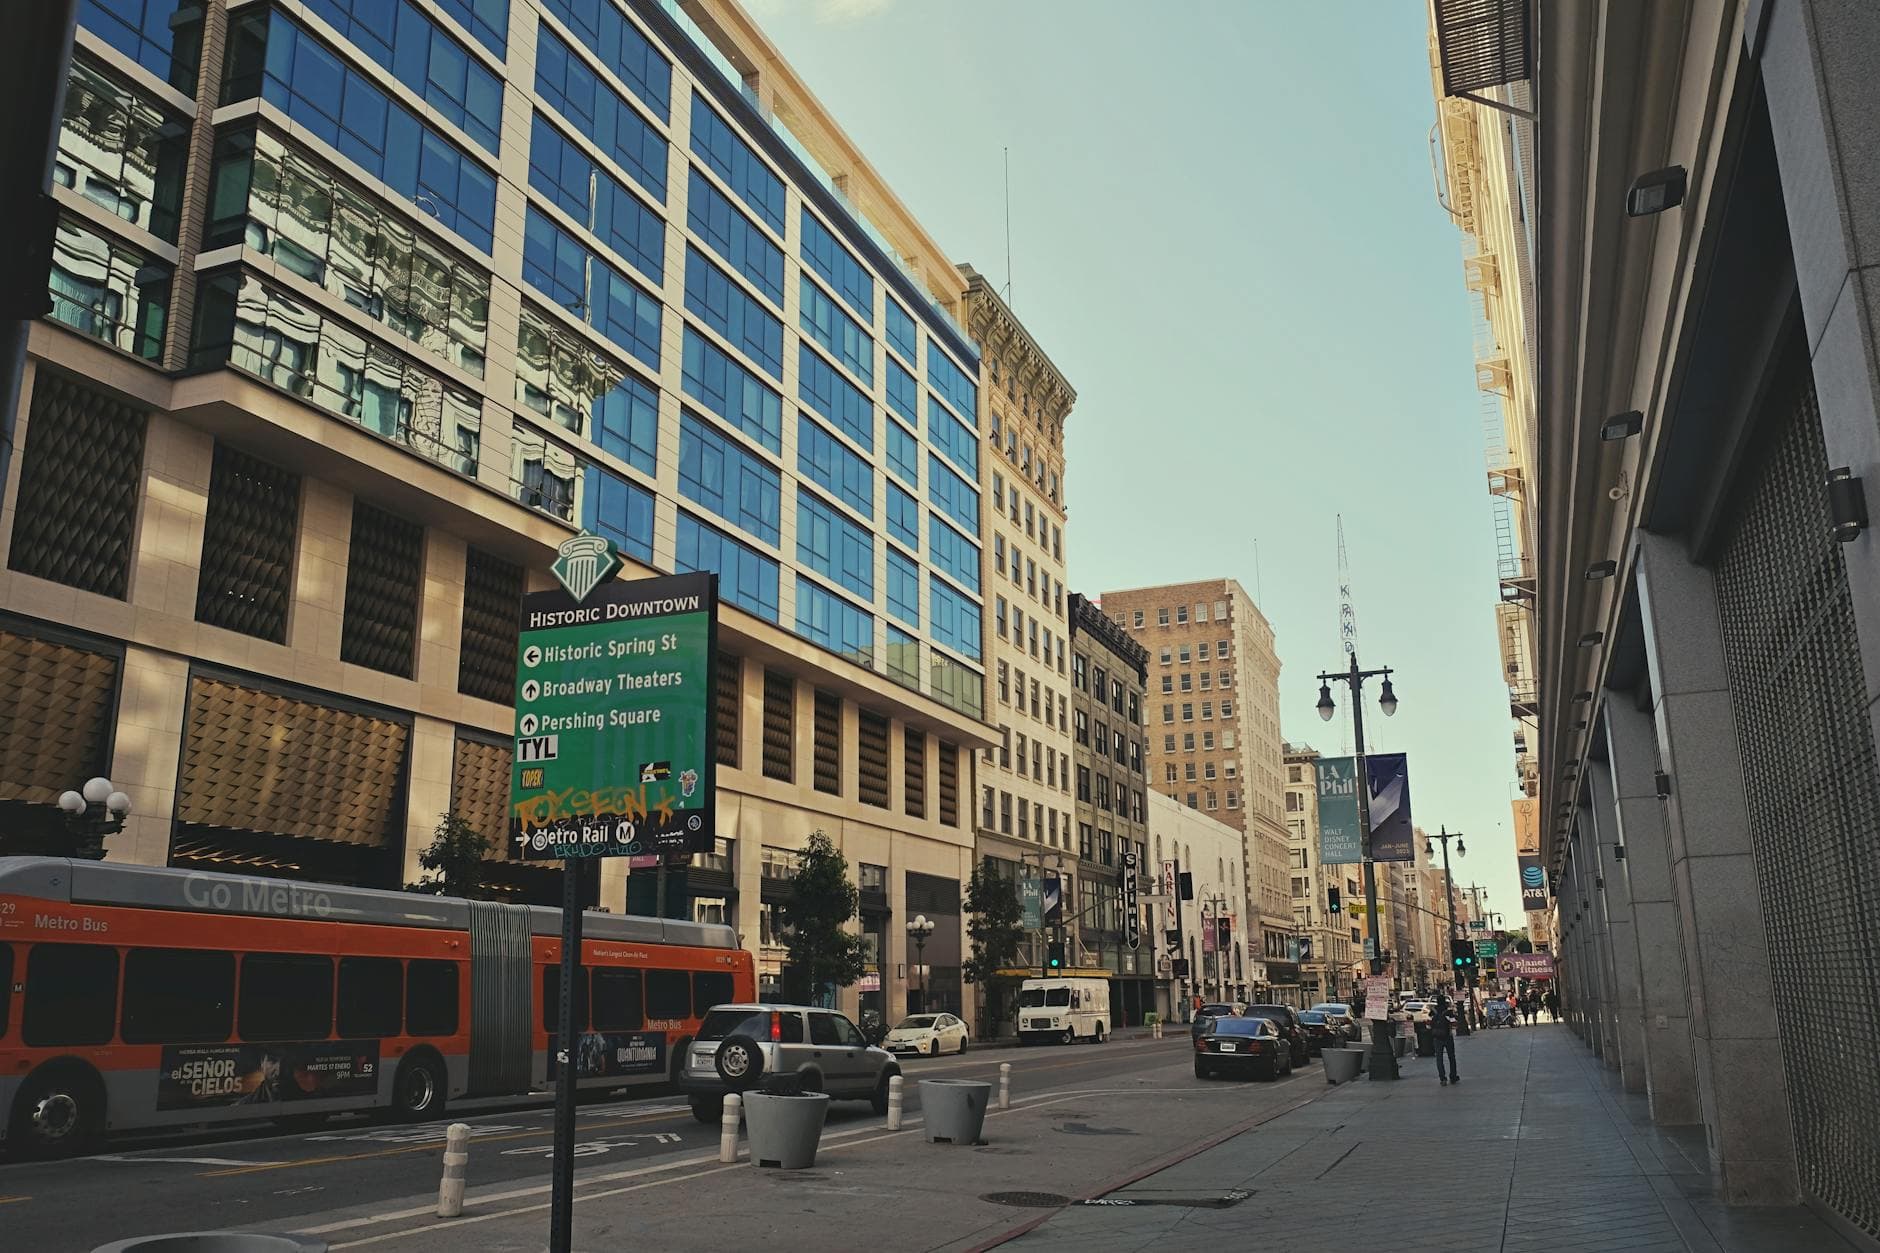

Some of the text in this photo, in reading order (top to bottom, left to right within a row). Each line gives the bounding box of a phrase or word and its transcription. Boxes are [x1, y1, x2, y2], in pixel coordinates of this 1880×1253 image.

[544, 633, 678, 663] Historic Spring St
[543, 671, 682, 698] Broadway Theaters
[541, 708, 661, 731] Pershing Square
[518, 737, 556, 761] TYL
[1319, 765, 1340, 780] LA
[1320, 778, 1353, 796] Phil
[583, 826, 609, 844] Rail
[1324, 842, 1356, 850] CONCERT
[184, 872, 332, 917] Go Metro
[1126, 855, 1137, 928] Sprint
[0, 902, 16, 914] 29
[34, 914, 79, 930] Metro
[83, 917, 108, 932] Bus
[1515, 959, 1547, 968] planet
[1520, 966, 1553, 974] fitness
[648, 1019, 682, 1030] Metro Bus
[171, 1057, 236, 1079] el SEÑOR
[336, 1071, 351, 1080] 9PM
[363, 1064, 373, 1072] 52
[191, 1077, 243, 1096] CIELOS
